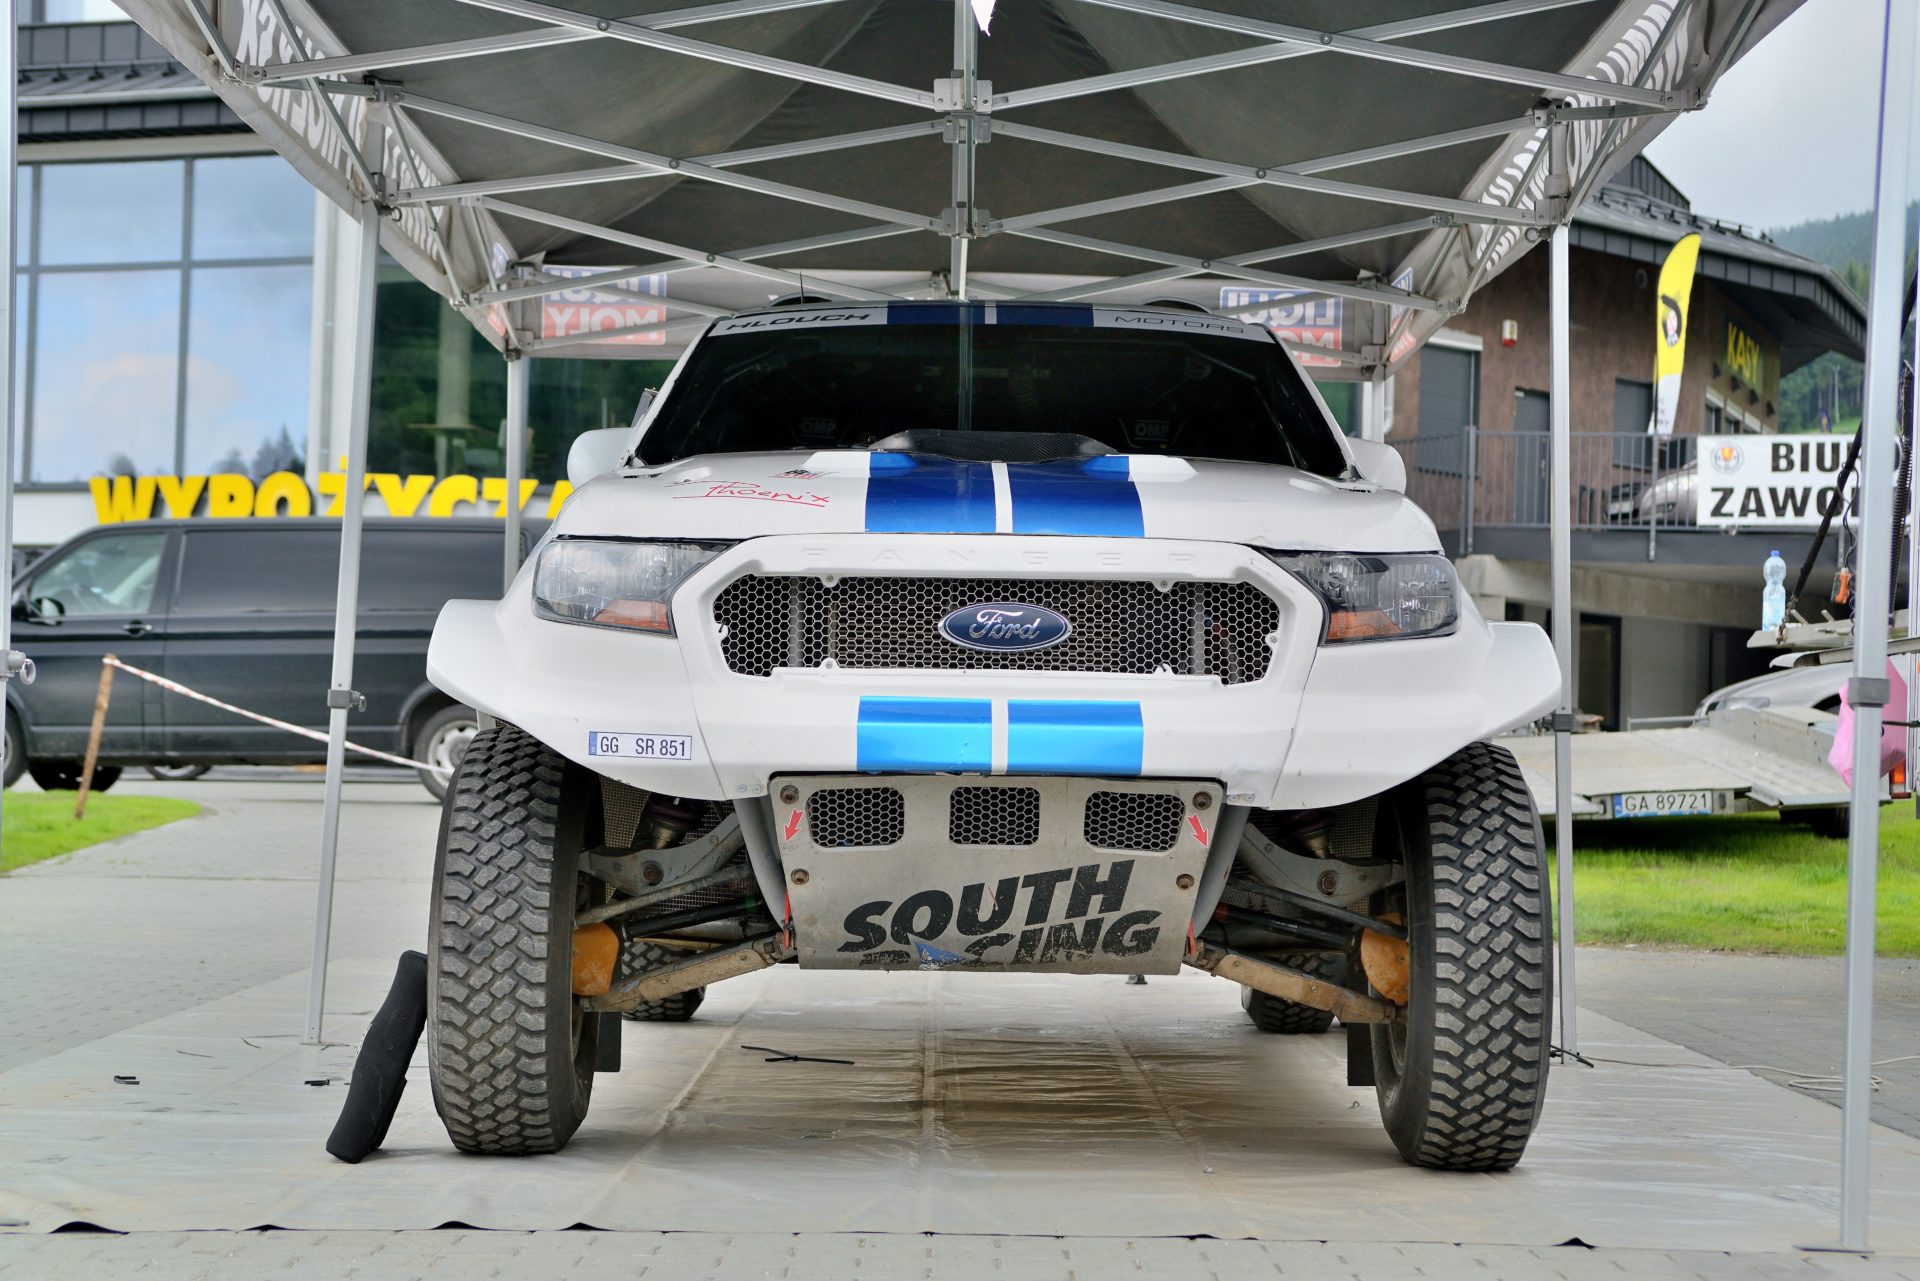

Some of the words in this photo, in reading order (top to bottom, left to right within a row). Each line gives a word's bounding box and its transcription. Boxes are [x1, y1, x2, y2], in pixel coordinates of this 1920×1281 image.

[726, 313, 871, 331] HLOUCH
[1115, 315, 1245, 334] MOTORS
[800, 421, 837, 436] OMP
[1135, 423, 1170, 438] OMP
[1771, 442, 1903, 473] BIU
[696, 481, 831, 505] Phoenix
[802, 547, 1195, 567] RANGER
[968, 609, 1042, 640] Ford
[600, 736, 619, 754] GG
[635, 737, 655, 755] SR
[659, 739, 686, 757] 851
[1625, 795, 1649, 812] GA
[1656, 793, 1707, 810] 89721
[837, 859, 1135, 953] SOUTH
